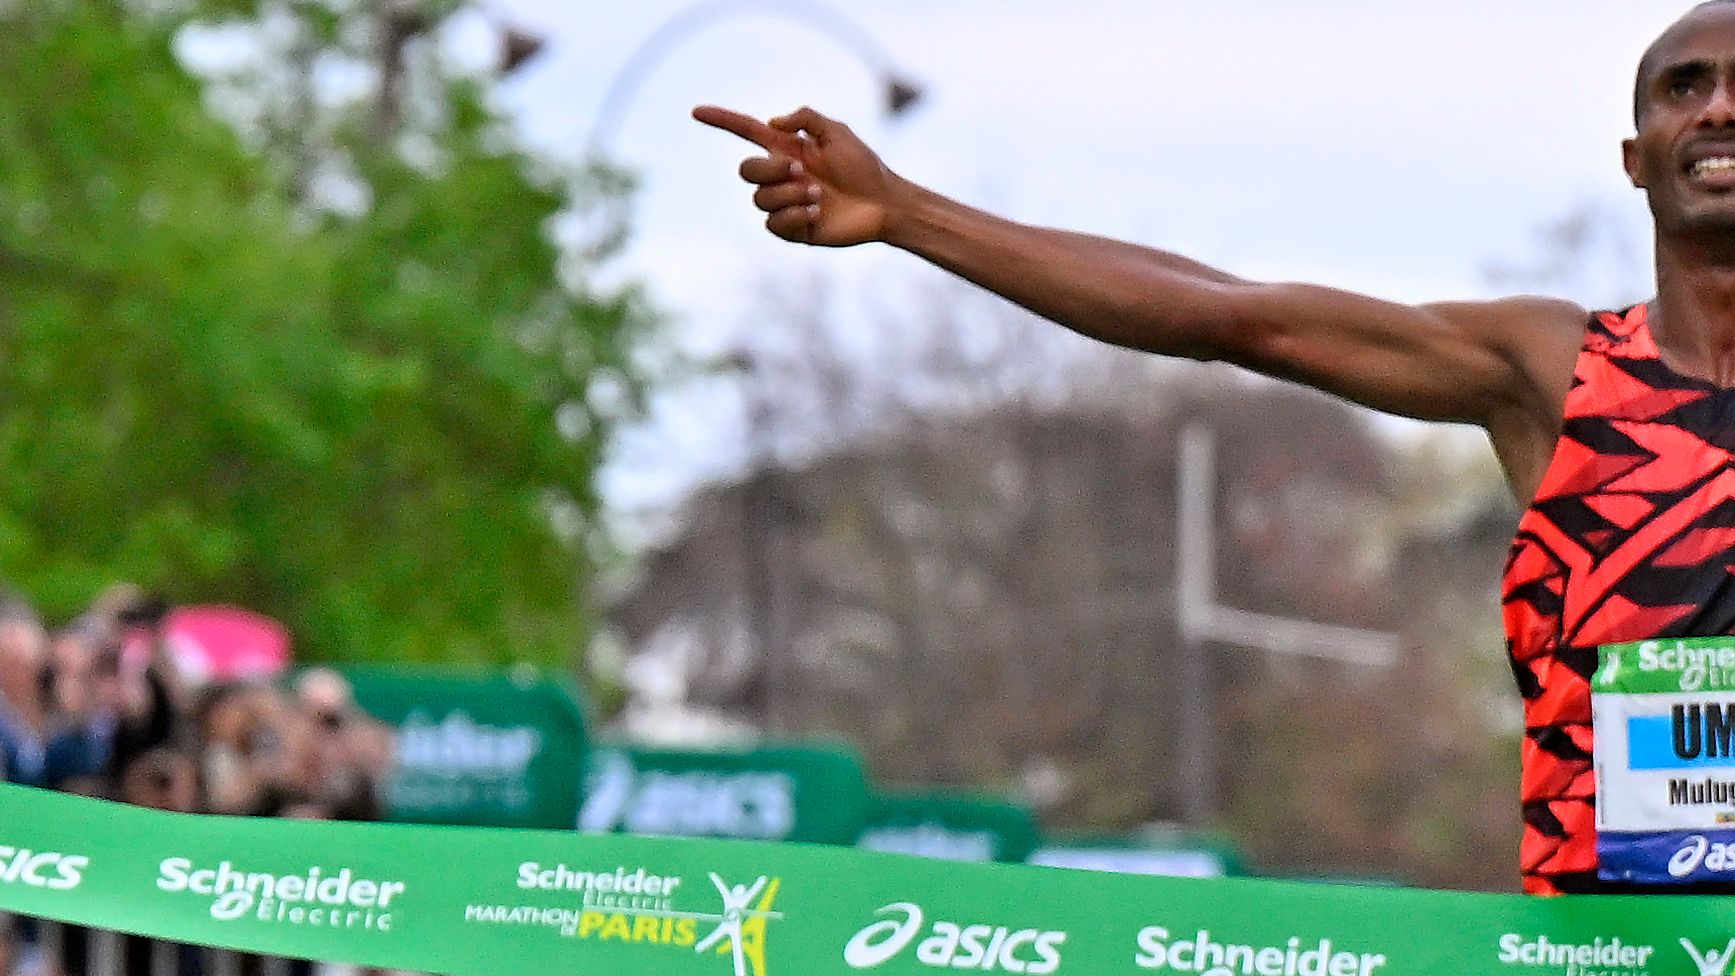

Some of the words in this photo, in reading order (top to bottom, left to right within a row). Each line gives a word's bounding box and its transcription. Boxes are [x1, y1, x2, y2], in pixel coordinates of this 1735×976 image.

[156, 857, 405, 907] Schneider
[516, 862, 681, 896] Schneider
[256, 897, 392, 931] Electric
[465, 904, 579, 927] MARATHON
[578, 911, 697, 946] PARIS
[1498, 933, 1654, 967] Schneider
